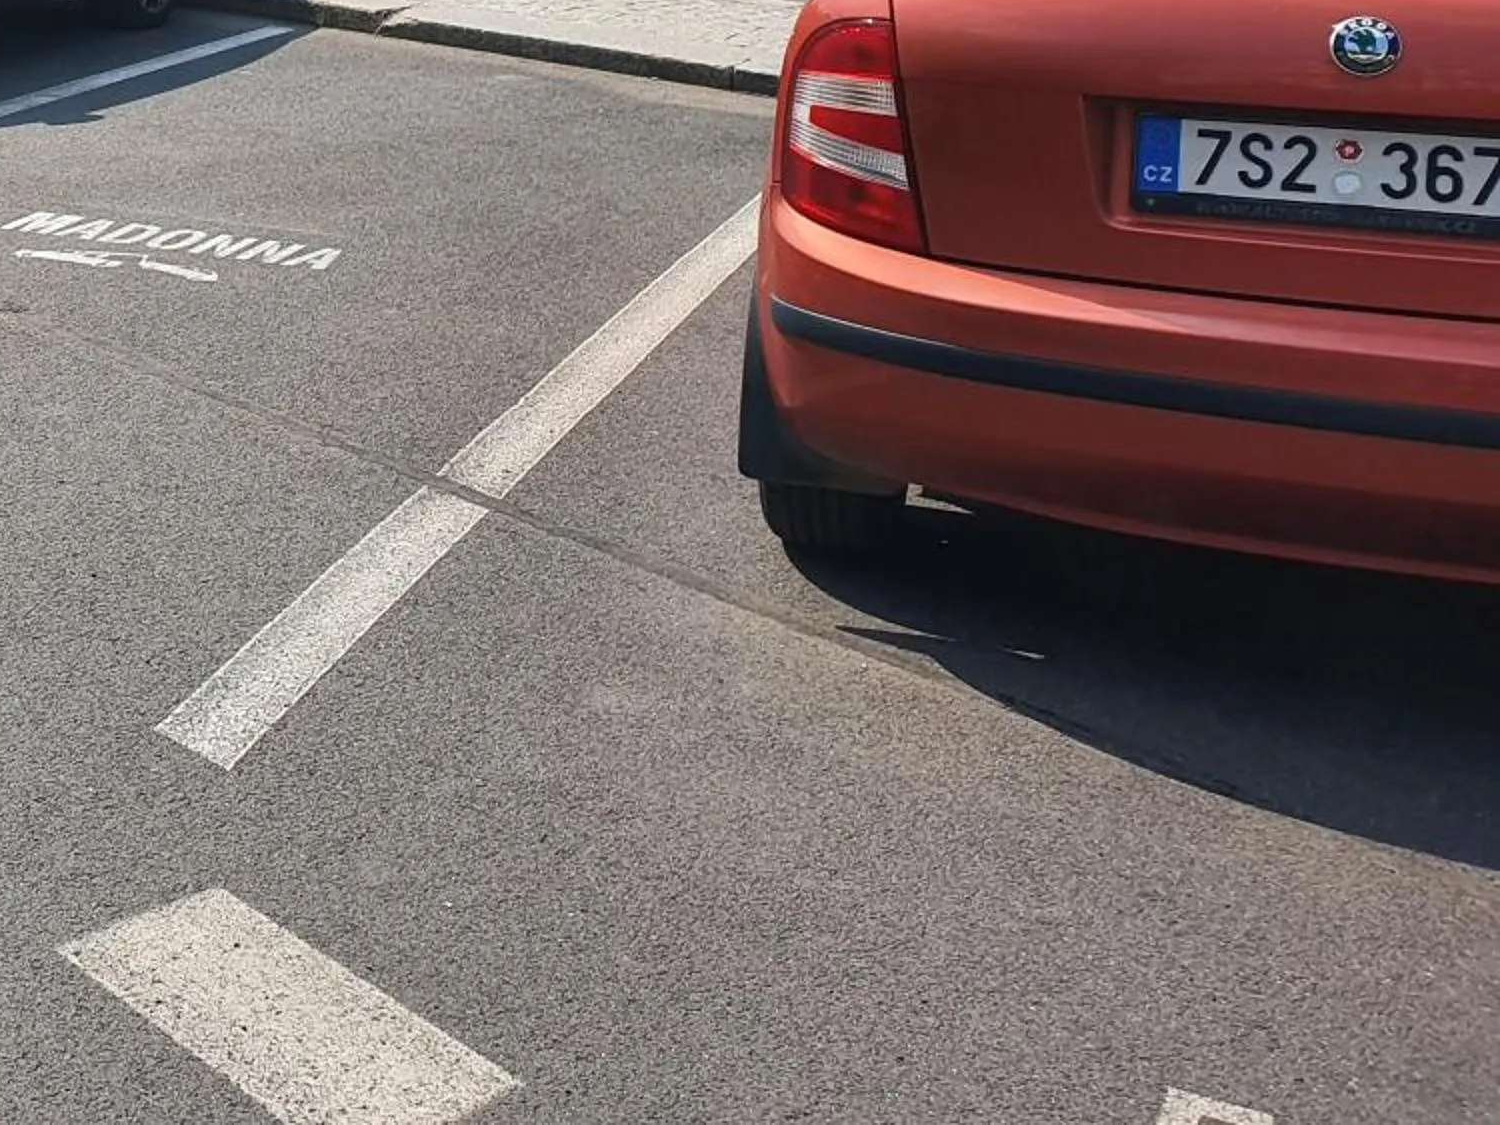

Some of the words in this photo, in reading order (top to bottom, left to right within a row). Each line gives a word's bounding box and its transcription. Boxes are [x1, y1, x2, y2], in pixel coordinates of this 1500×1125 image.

[1143, 165, 1173, 182] CZ
[1195, 129, 1317, 193] 7S2
[1380, 142, 1500, 206] 367
[0, 211, 342, 270] MADONNA
